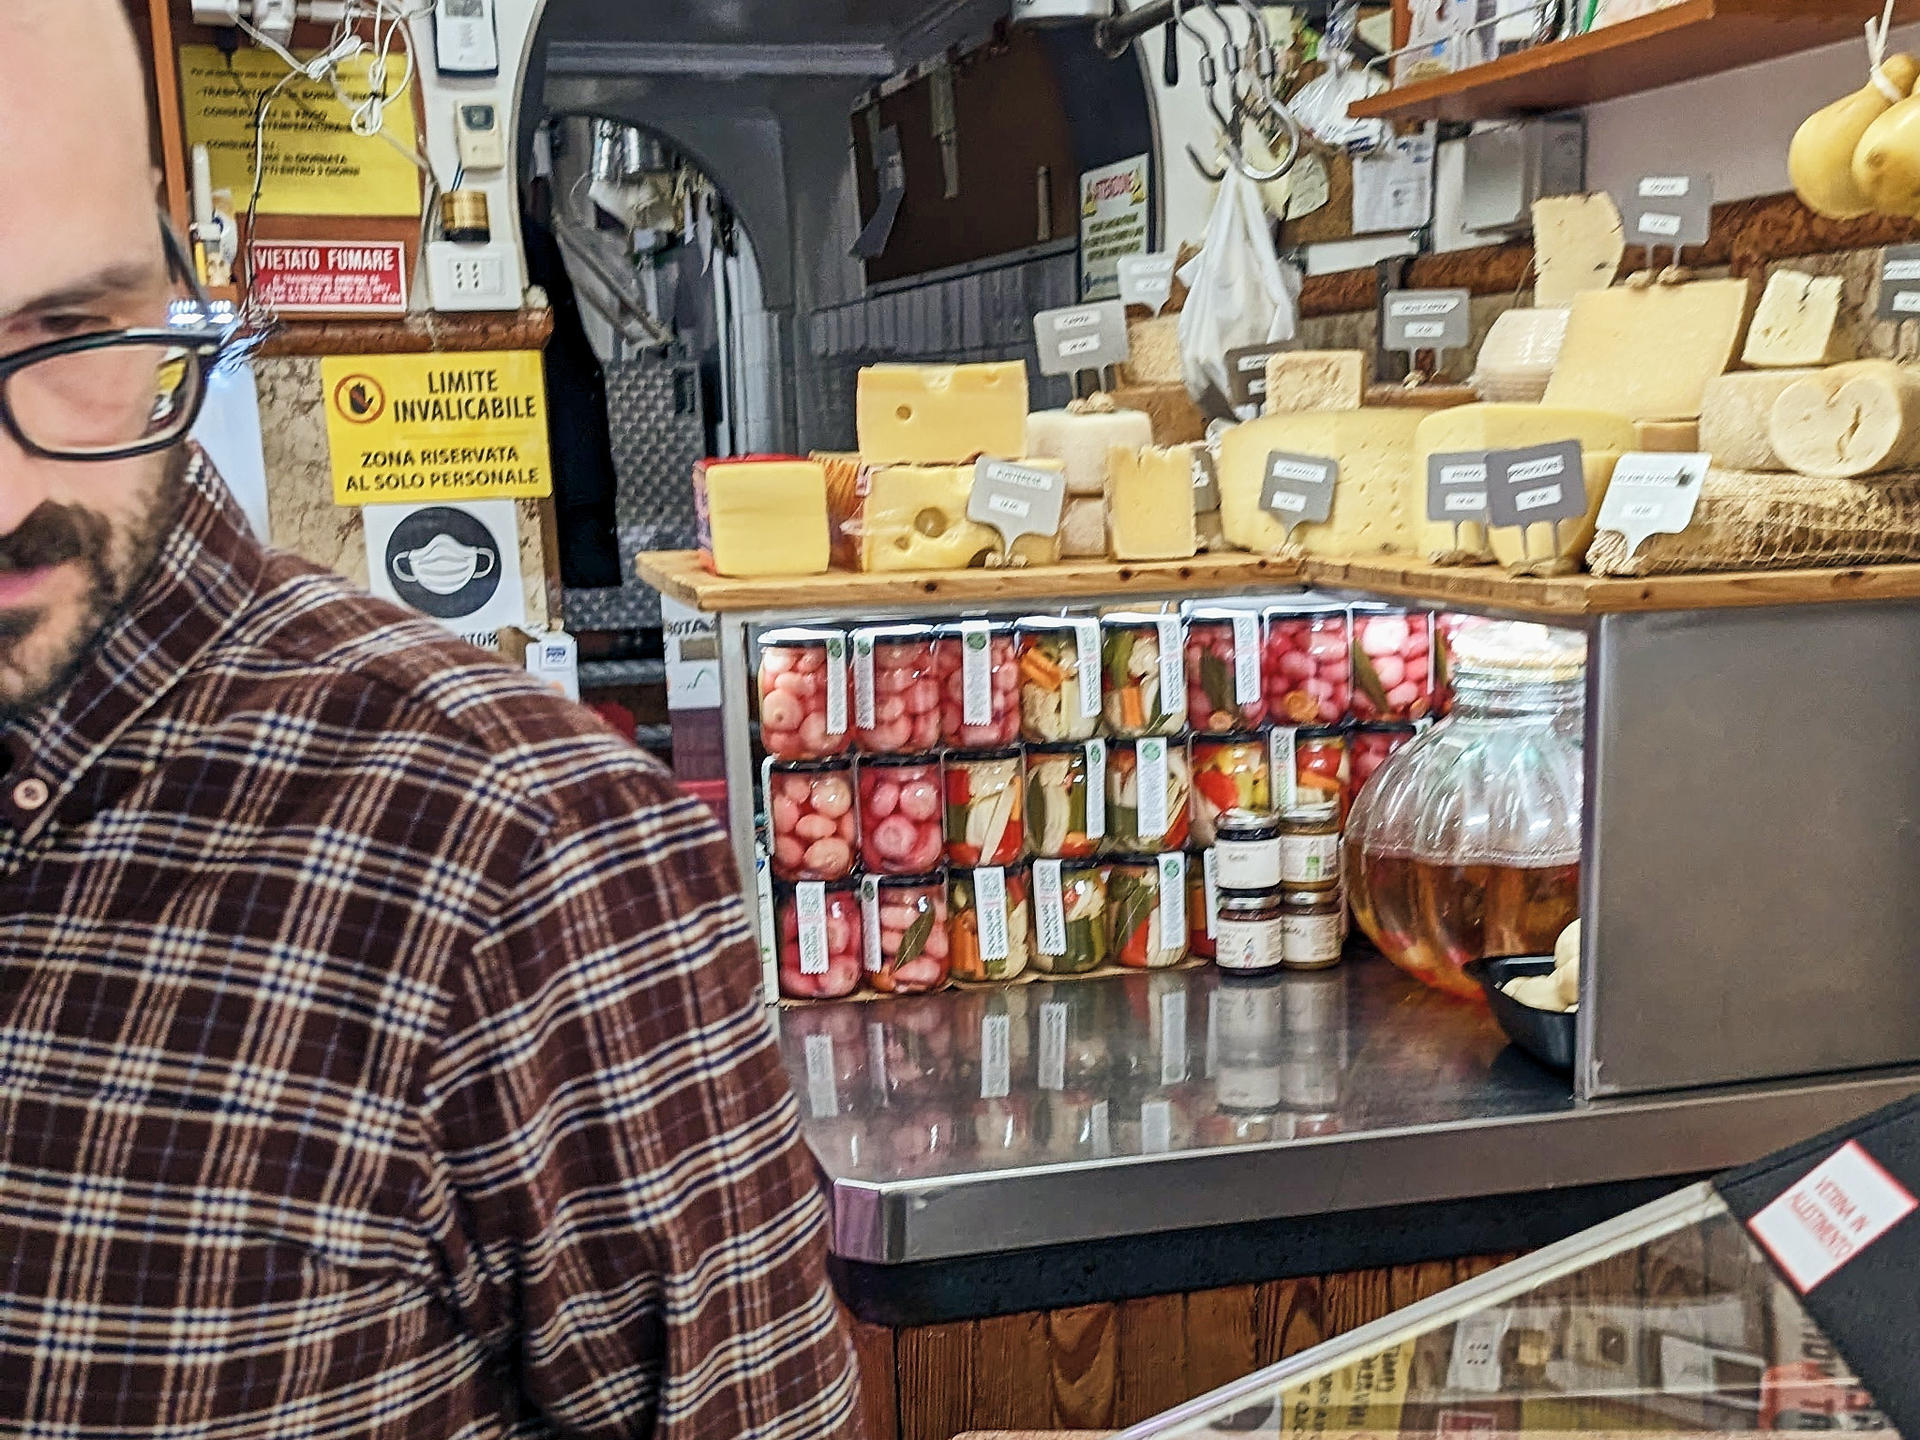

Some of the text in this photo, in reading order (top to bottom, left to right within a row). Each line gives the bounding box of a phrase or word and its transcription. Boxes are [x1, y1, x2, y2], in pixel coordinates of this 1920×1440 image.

[256, 248, 395, 271] VIETATO FUMARE
[428, 369, 498, 394] LIMITE
[393, 395, 537, 423] INVALICABILE
[360, 446, 519, 468] ZONA RISERVATA
[345, 467, 540, 492] AL SOLO PERSONALE
